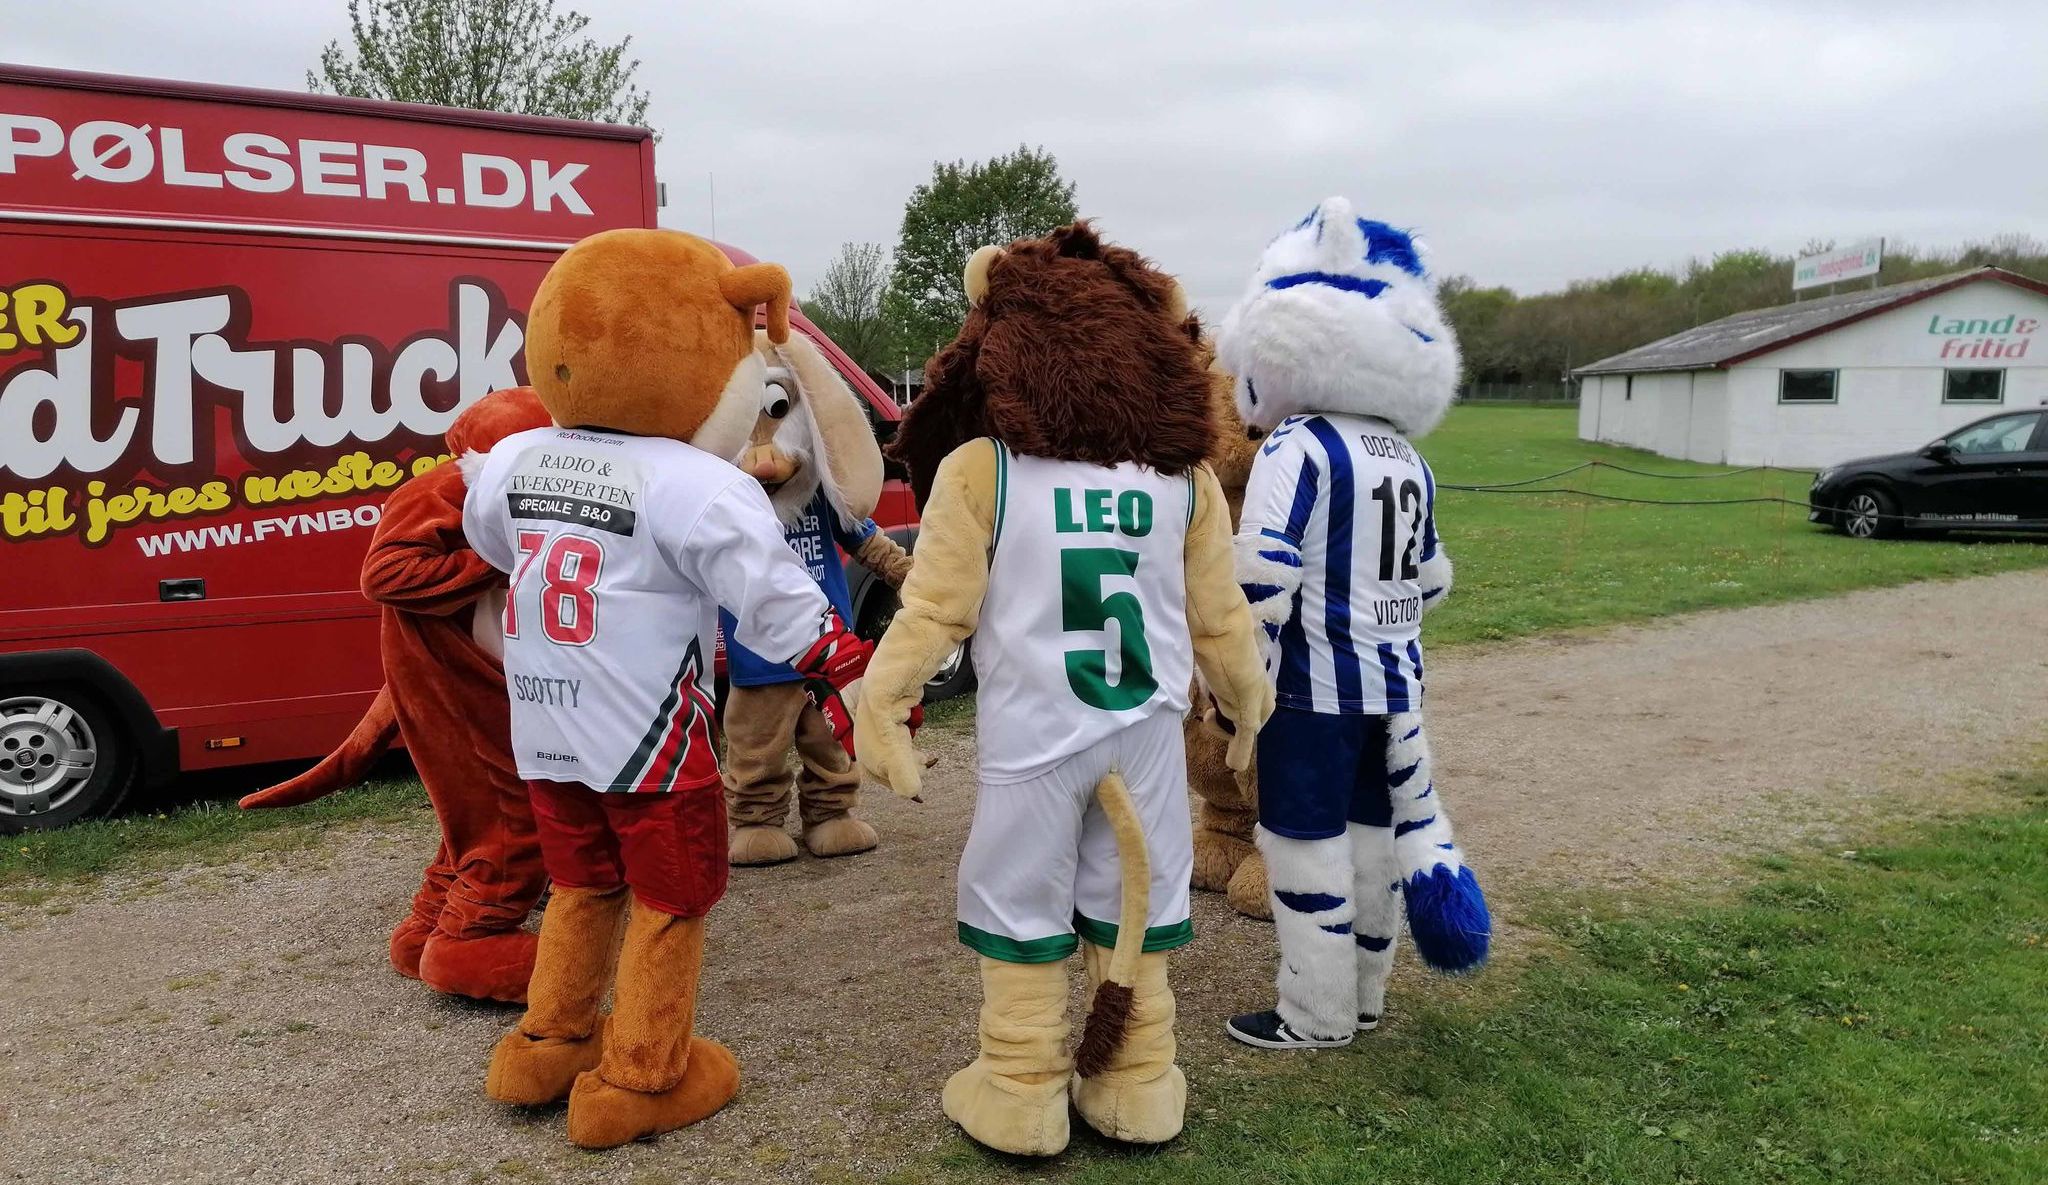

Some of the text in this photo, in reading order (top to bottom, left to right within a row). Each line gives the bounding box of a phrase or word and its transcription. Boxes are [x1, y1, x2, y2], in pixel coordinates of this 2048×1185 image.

[0, 113, 594, 216] PØLSER.DK
[512, 475, 637, 507] TV-EKSPERTEN
[538, 454, 613, 477] RADIO &
[0, 486, 76, 537] til
[87, 481, 231, 543] jeres
[244, 451, 403, 503] næste
[518, 498, 612, 523] SPECIALE B&O
[1053, 487, 1154, 538] LEO
[136, 503, 385, 557] WWW.FYNBO
[802, 515, 820, 532] ER
[1372, 475, 1422, 581] 12
[505, 529, 606, 648] 78
[1374, 596, 1419, 626] VICTOR
[1060, 547, 1160, 712] 5
[514, 673, 581, 708] SCOTTY
